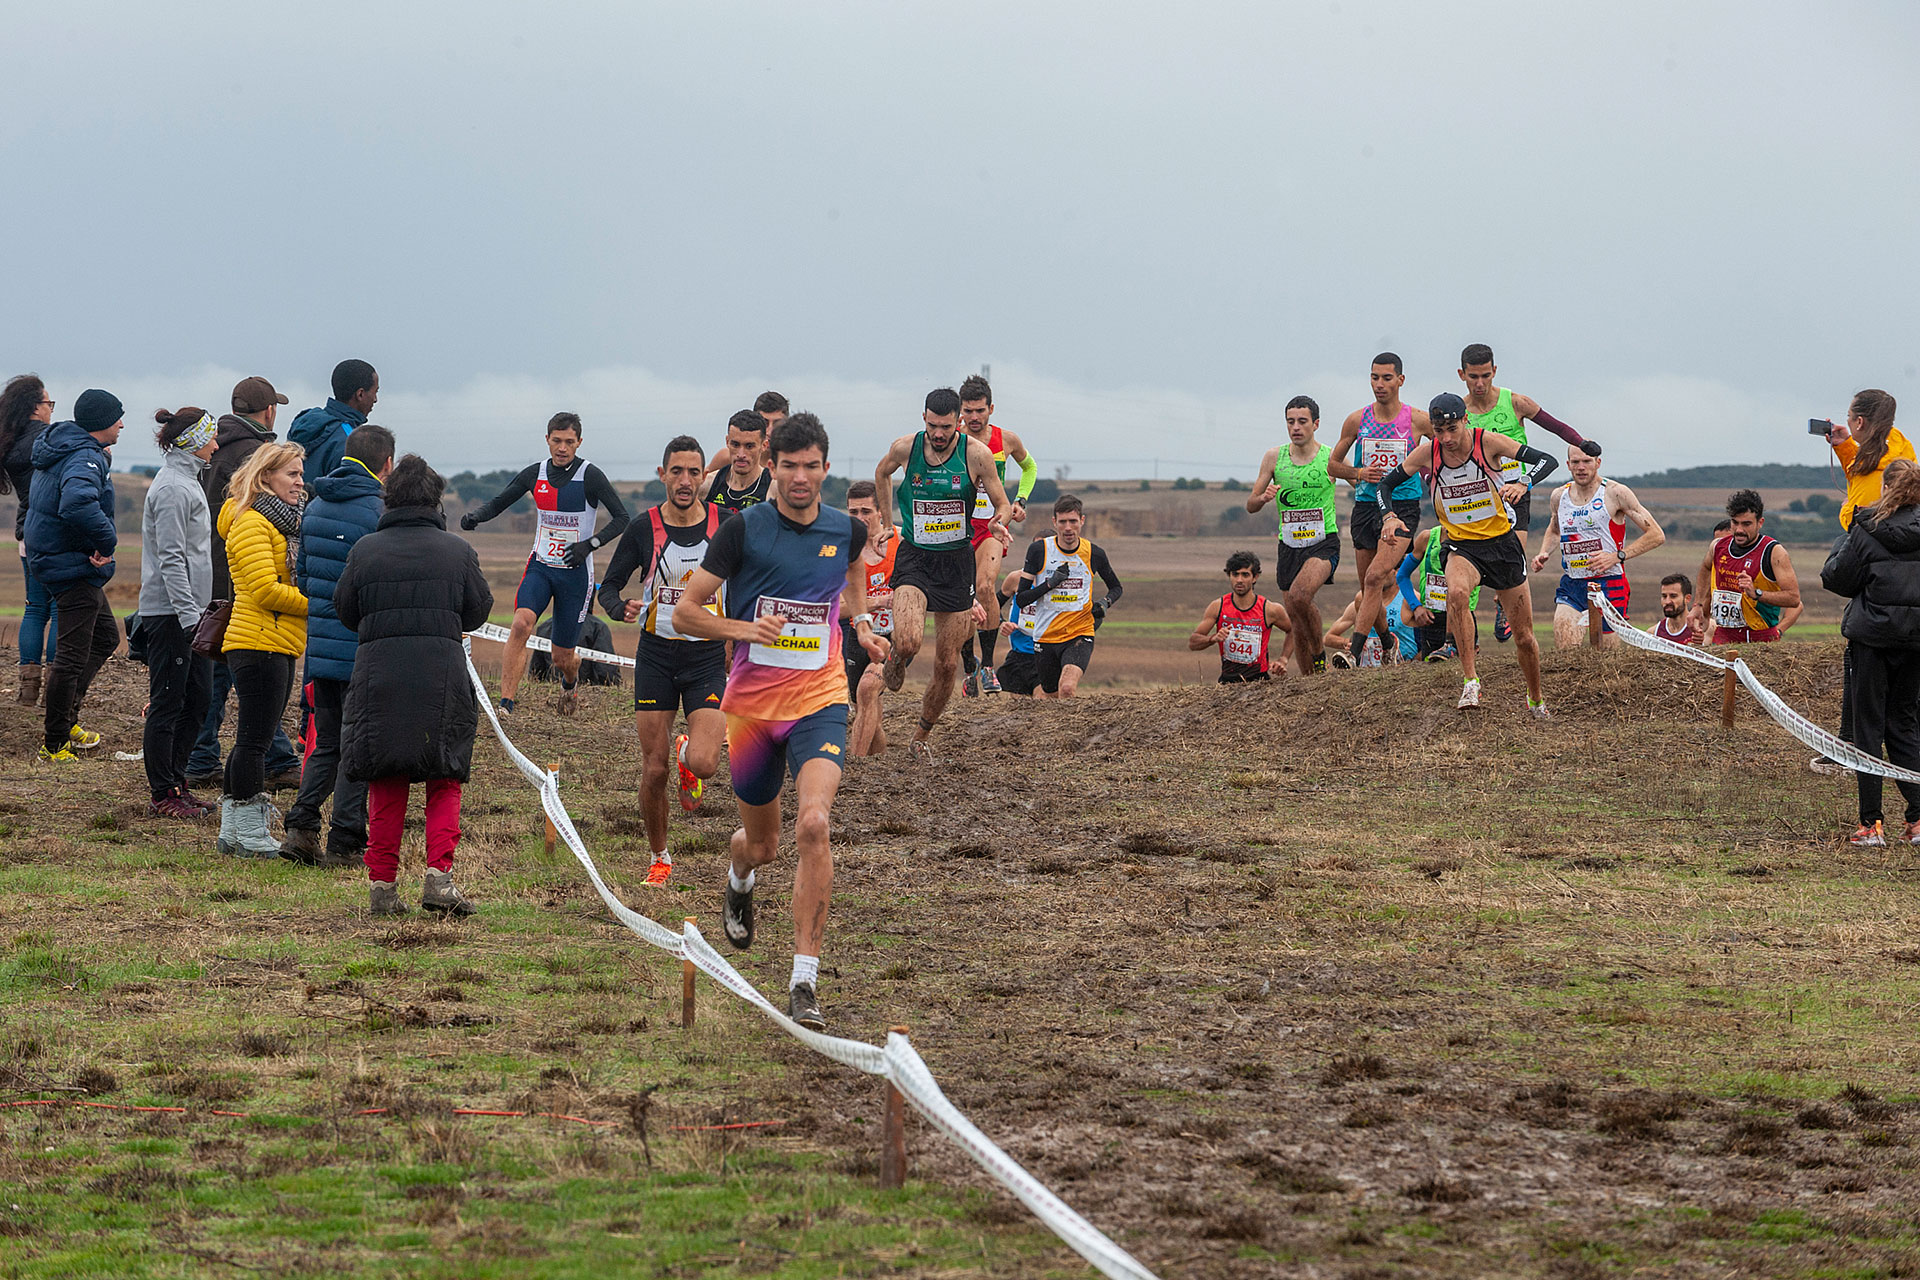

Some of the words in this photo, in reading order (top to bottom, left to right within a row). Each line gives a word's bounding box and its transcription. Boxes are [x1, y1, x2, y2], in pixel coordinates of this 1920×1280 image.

[1370, 454, 1398, 468] 293
[1451, 482, 1486, 492] Diputación
[1462, 487, 1486, 496] Segovia
[1449, 499, 1491, 512] FERNANDEZ
[924, 522, 960, 531] CATROFE
[548, 543, 566, 557] 25
[1571, 541, 1599, 549] Diputación
[777, 602, 825, 615] Diputación
[791, 613, 823, 624] Segovia
[870, 612, 889, 627] 75
[790, 627, 797, 637] 1
[774, 638, 820, 649] ECHAAL
[1229, 642, 1253, 656] 944
